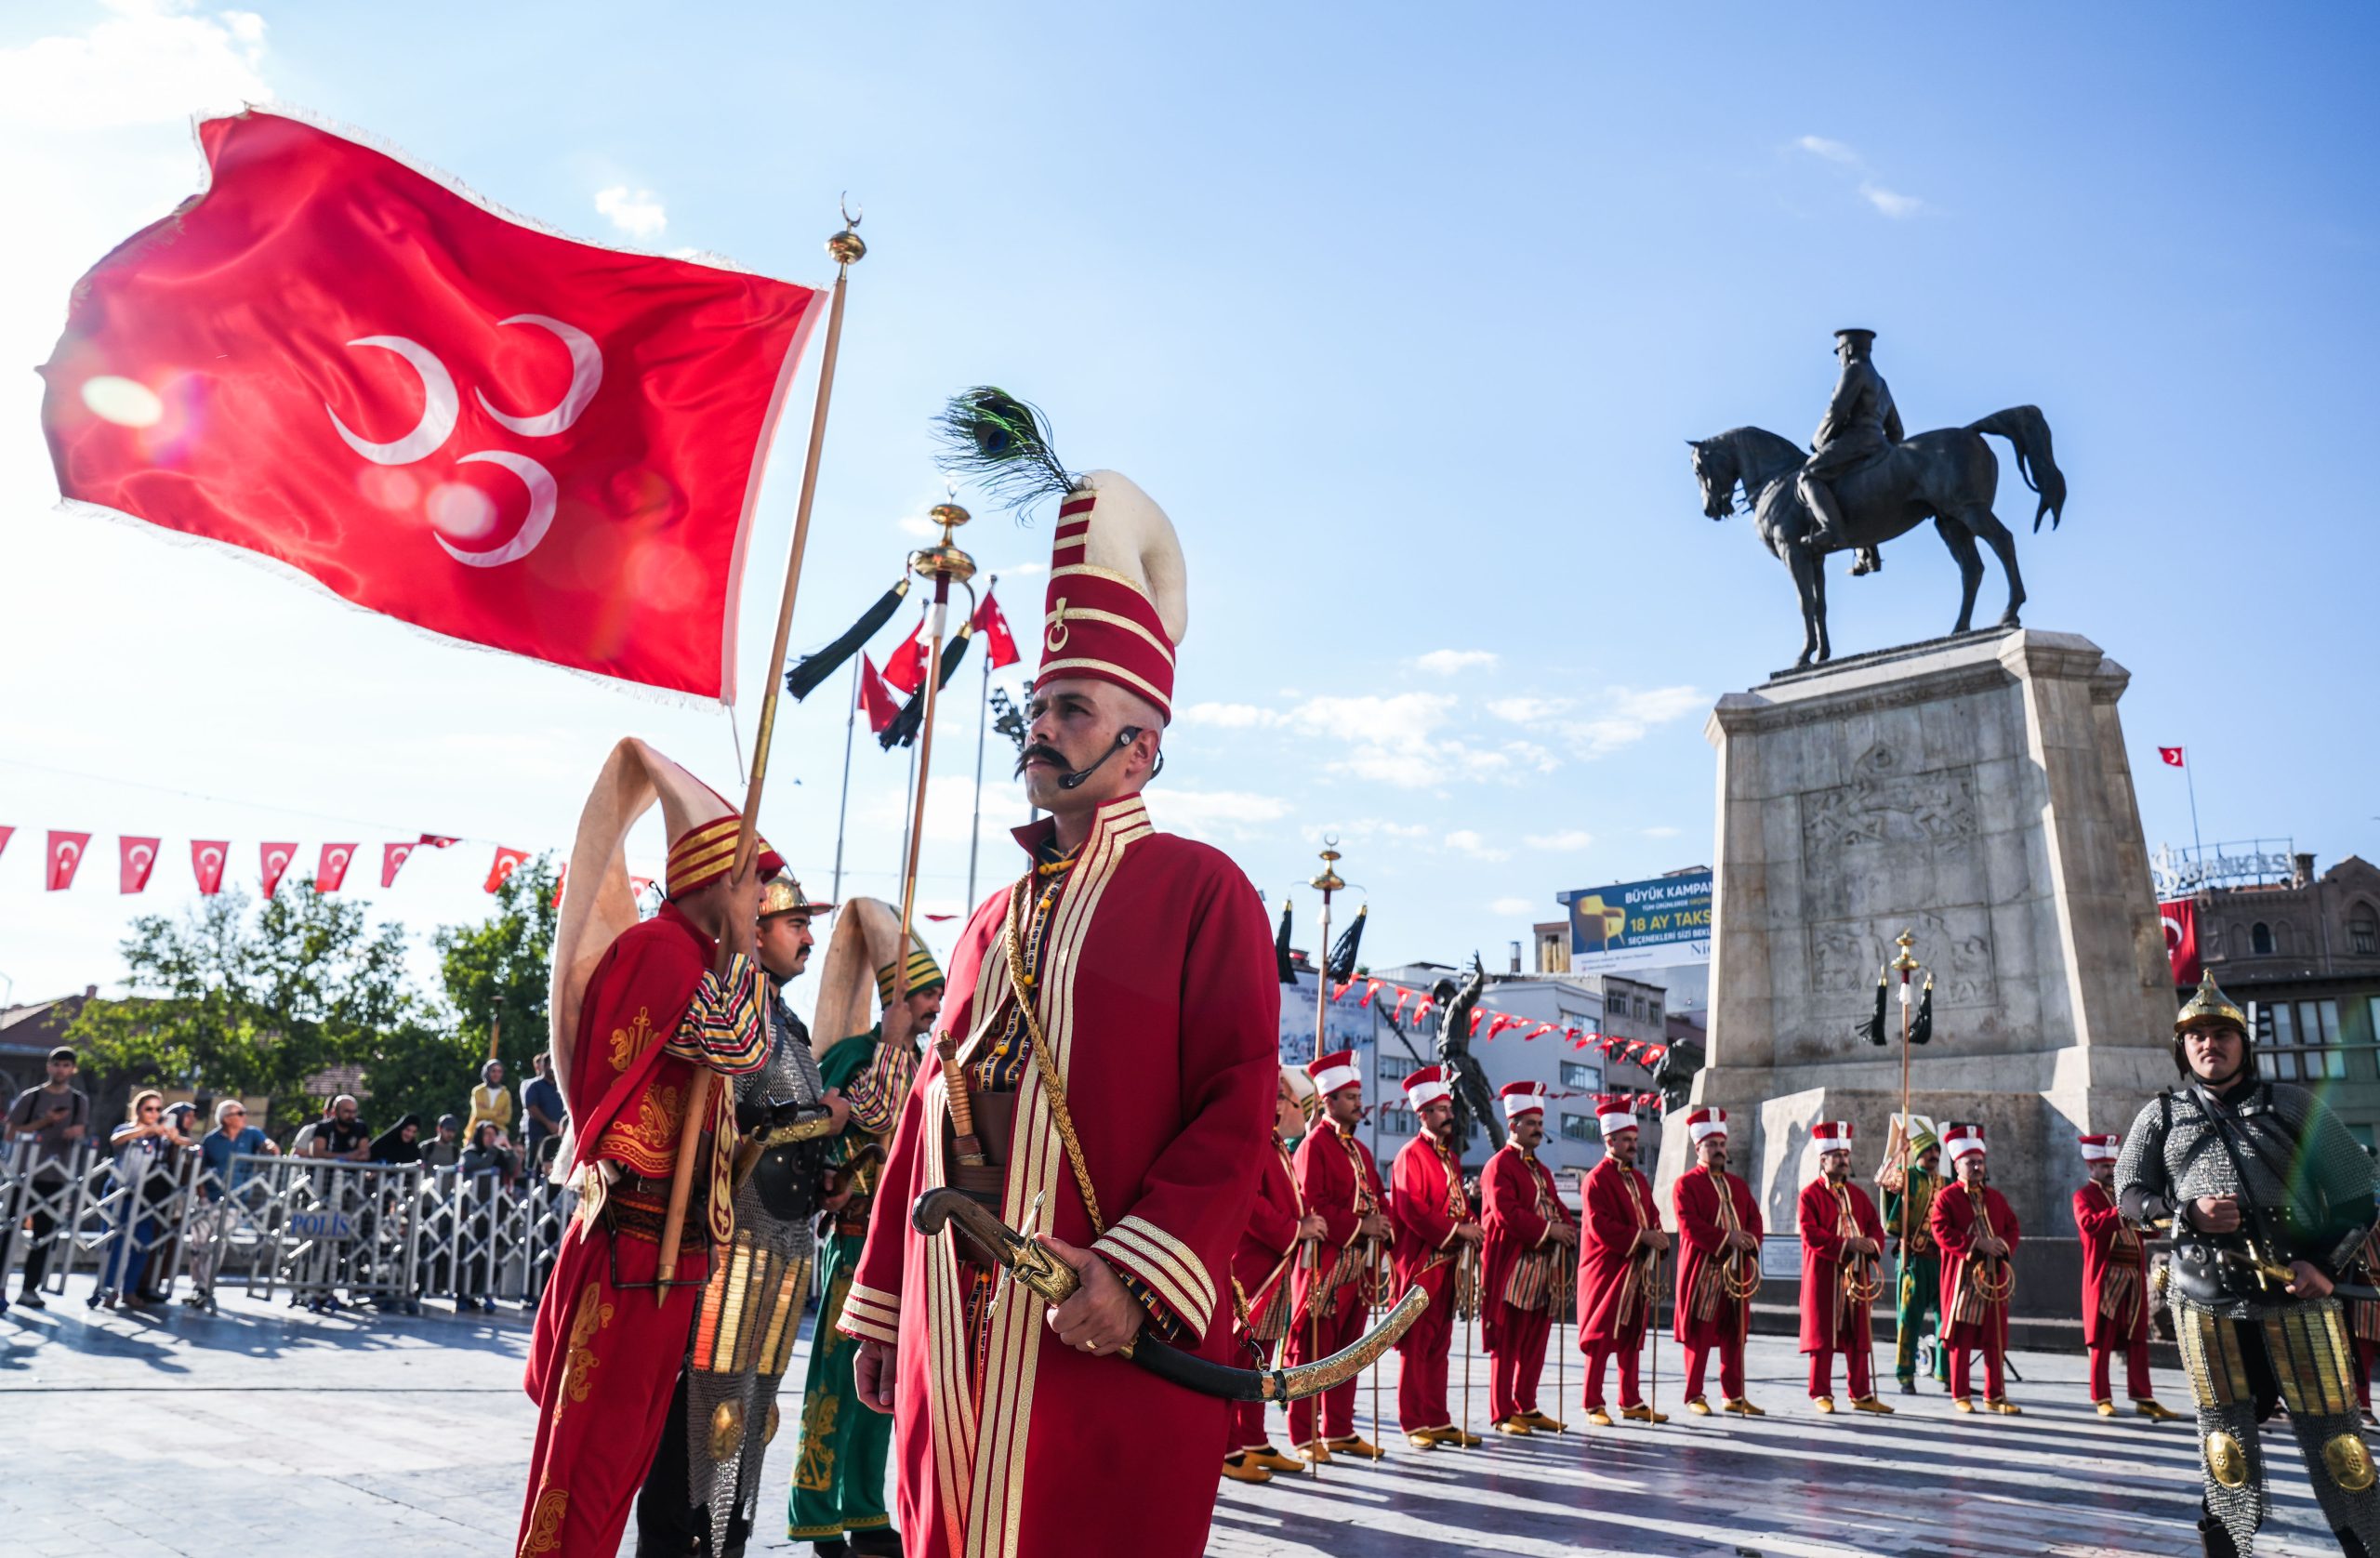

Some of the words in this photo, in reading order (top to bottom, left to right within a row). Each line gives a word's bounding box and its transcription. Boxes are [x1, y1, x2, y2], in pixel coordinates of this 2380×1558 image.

[1625, 887, 1664, 904] BÜYÜK
[1631, 918, 1646, 932] 18
[1650, 915, 1670, 930] AY
[291, 1211, 350, 1235] POLİS
